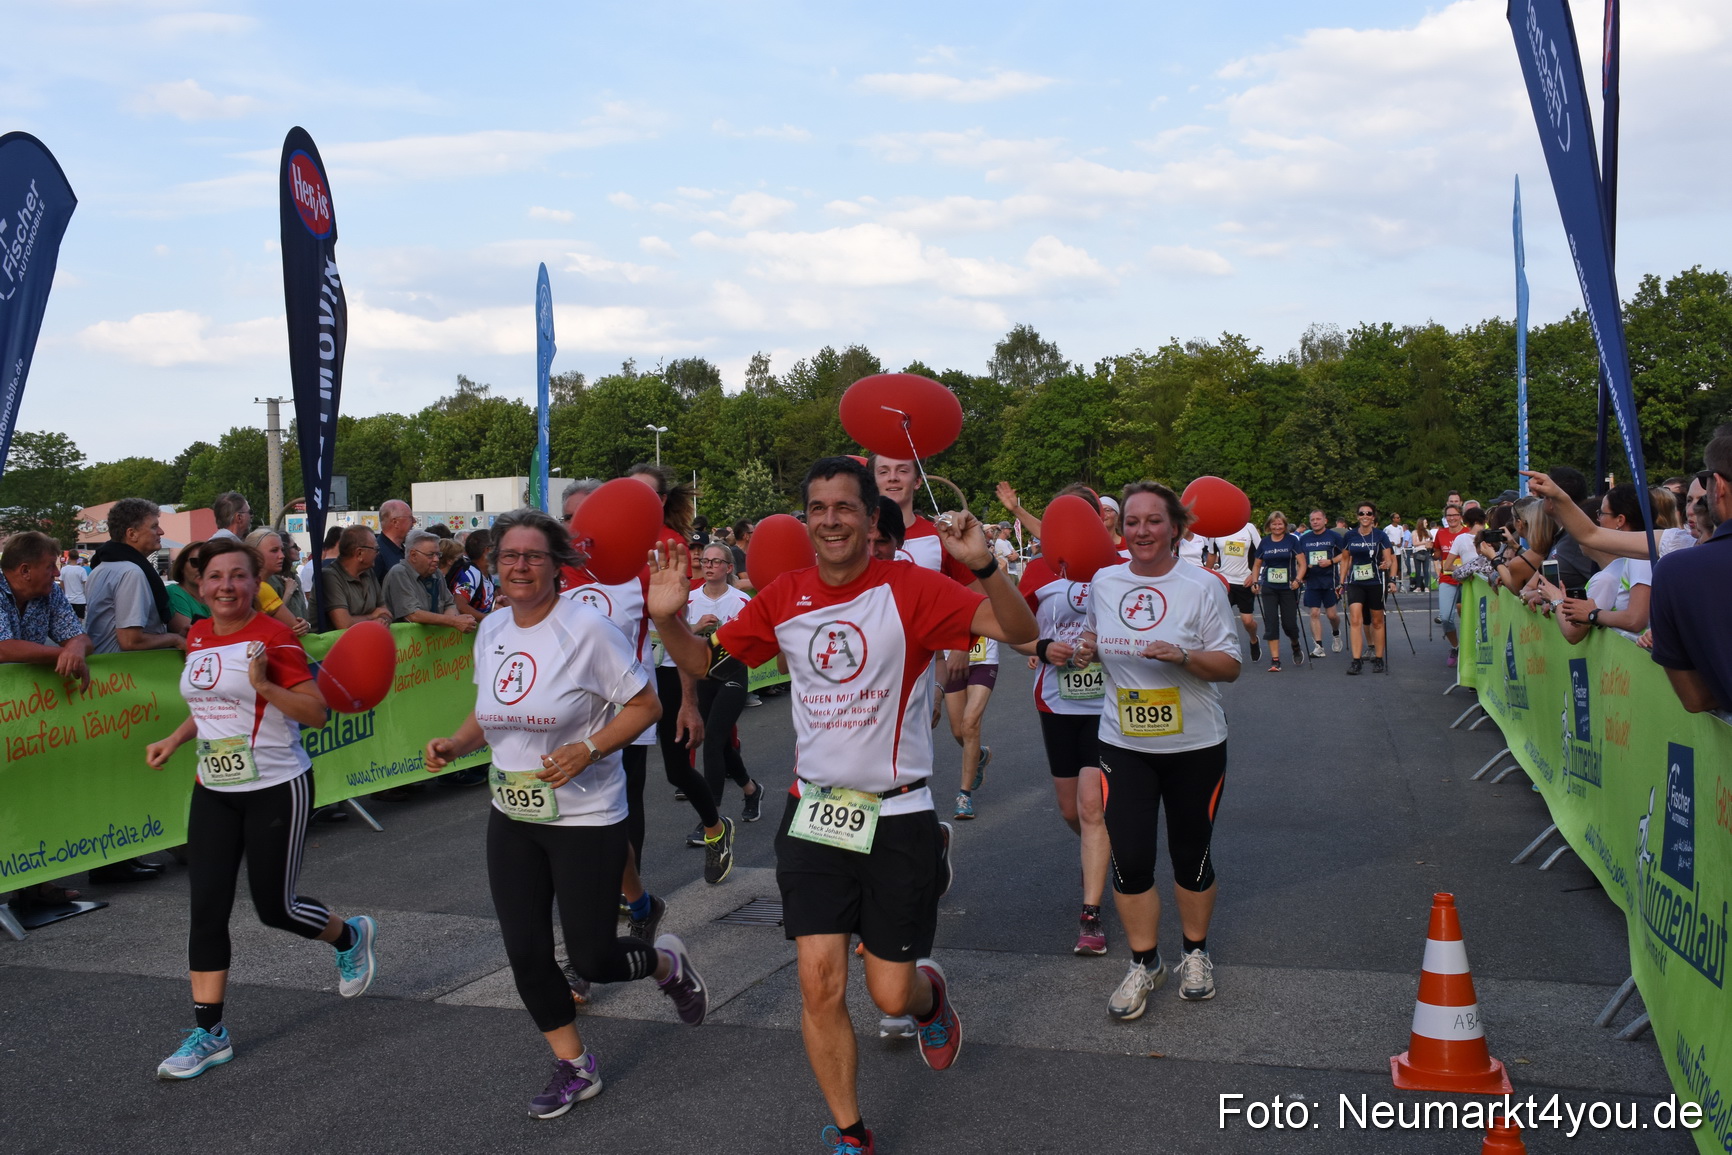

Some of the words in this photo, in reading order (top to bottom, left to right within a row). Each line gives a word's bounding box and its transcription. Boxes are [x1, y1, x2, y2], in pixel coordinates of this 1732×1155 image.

[291, 162, 330, 221] Hervis
[2, 178, 39, 282] Fischer
[18, 199, 45, 282] AUTOMOBILE
[425, 631, 463, 655] Firmen
[1100, 636, 1130, 645] LAUFEN
[1134, 639, 1150, 647] MIT
[394, 664, 431, 693] laufen
[432, 645, 476, 681] länger!
[1063, 672, 1103, 688] 1904
[836, 693, 854, 702] MIT
[860, 689, 890, 700] HERZ
[477, 711, 503, 722] LAUFEN
[507, 715, 522, 723] MIT
[526, 715, 556, 725] HERZ
[851, 705, 879, 714] Röschl
[1125, 705, 1173, 723] 1898
[6, 720, 78, 762] laufen
[82, 691, 160, 740] länger!
[204, 753, 245, 773] 1903
[497, 786, 545, 807] 1895
[1671, 784, 1691, 813] Fischer
[808, 801, 865, 831] 1899
[808, 823, 823, 832] Heck
